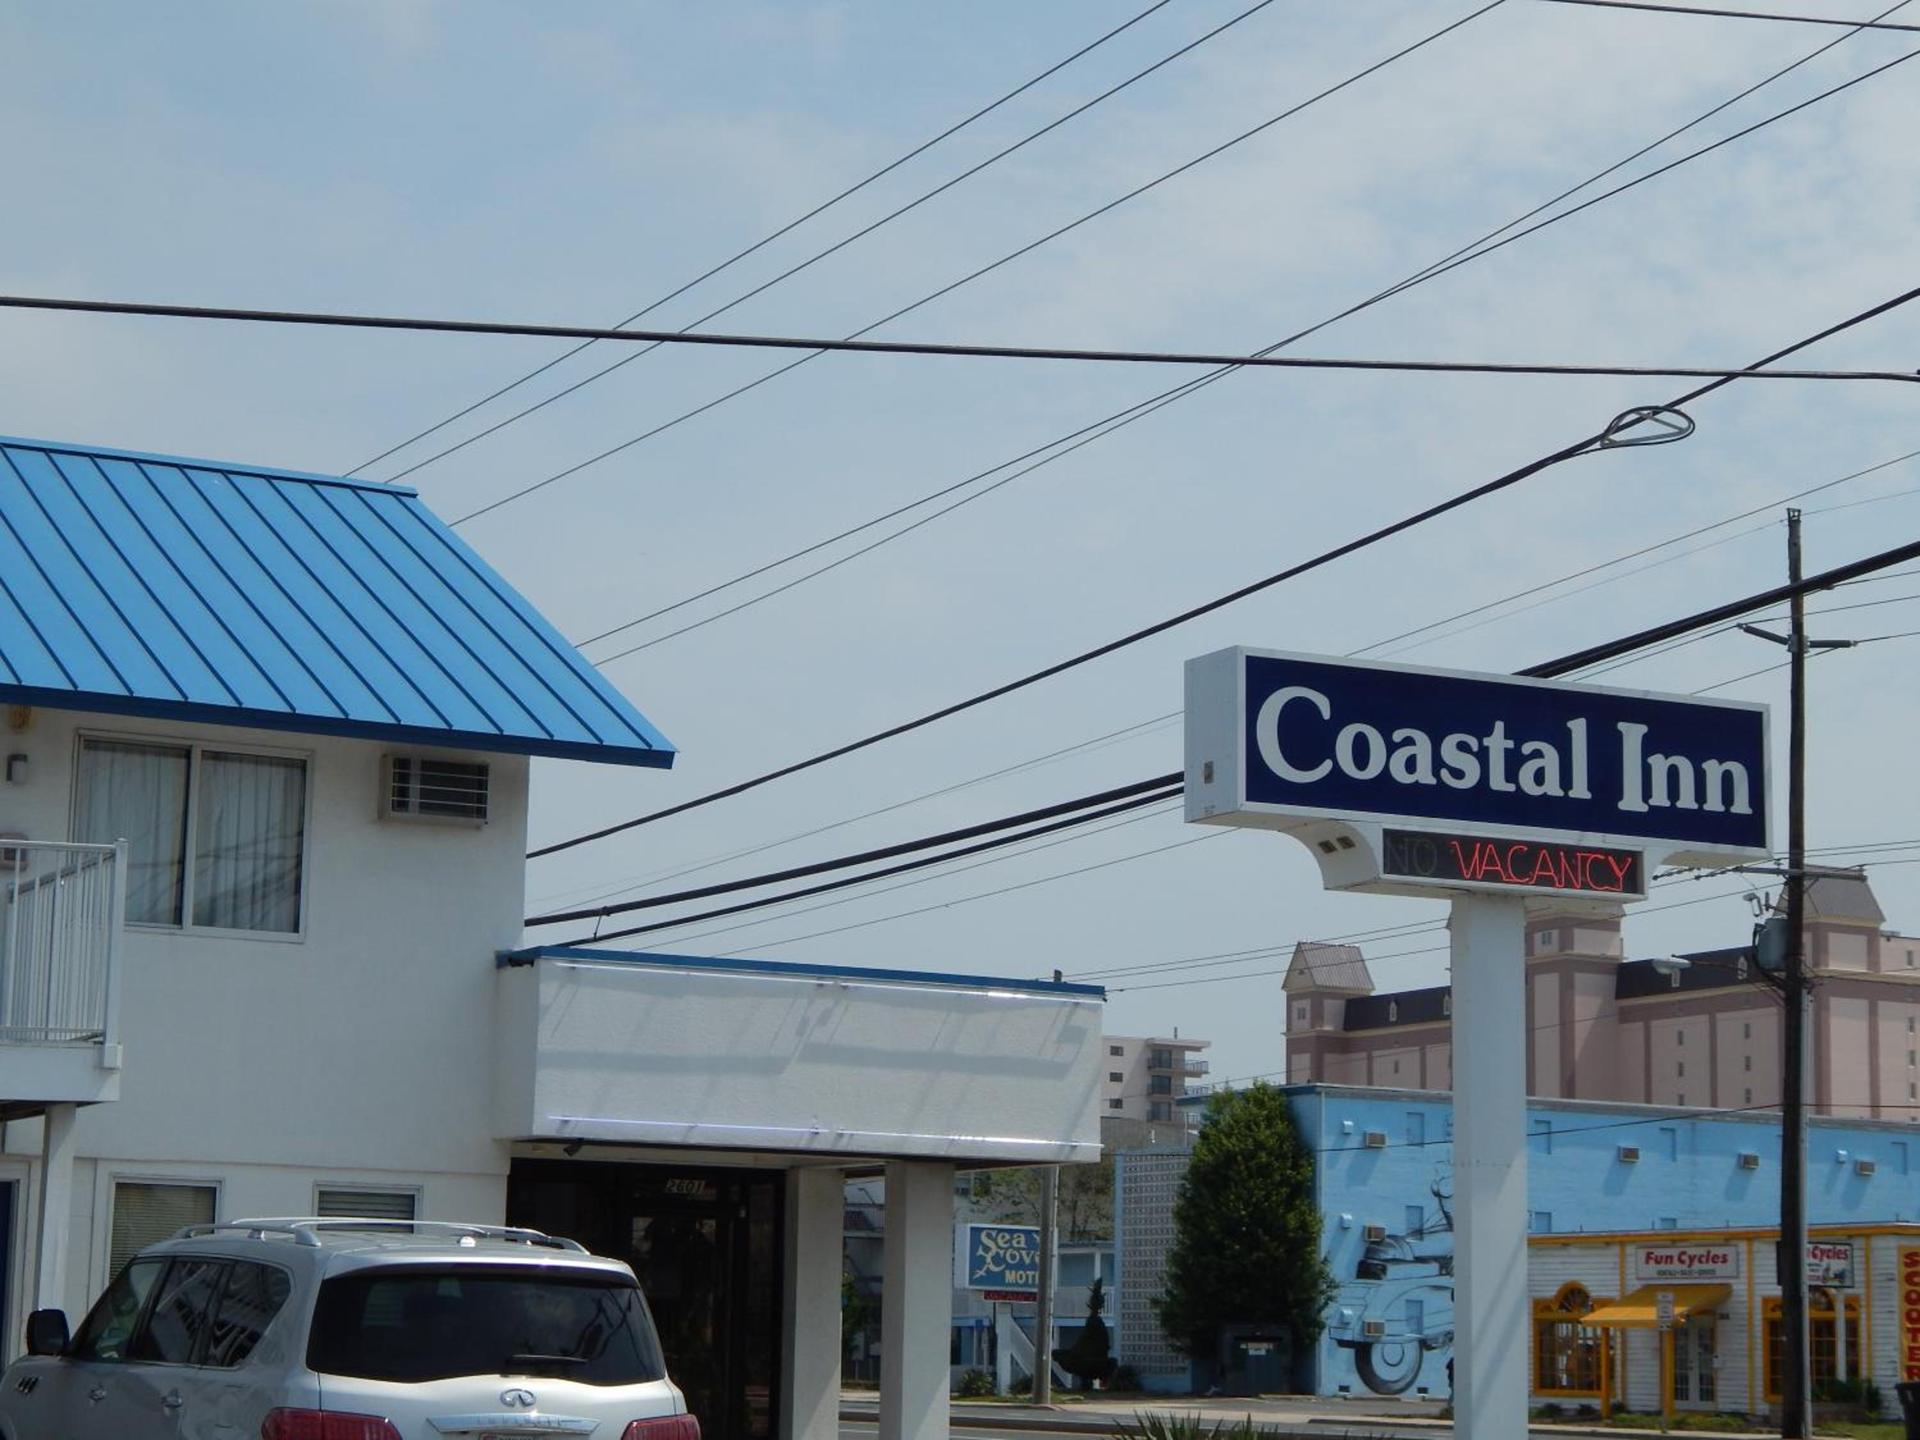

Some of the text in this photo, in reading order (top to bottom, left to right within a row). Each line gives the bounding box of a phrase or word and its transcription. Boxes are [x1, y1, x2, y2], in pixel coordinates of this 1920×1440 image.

[1256, 685, 1753, 814] Coastal Inn
[1385, 835, 1632, 892] NO VACANCY
[979, 1229, 1027, 1254] Sea
[1811, 1245, 1849, 1262] Cycles
[1644, 1250, 1729, 1268] Fun Cycles
